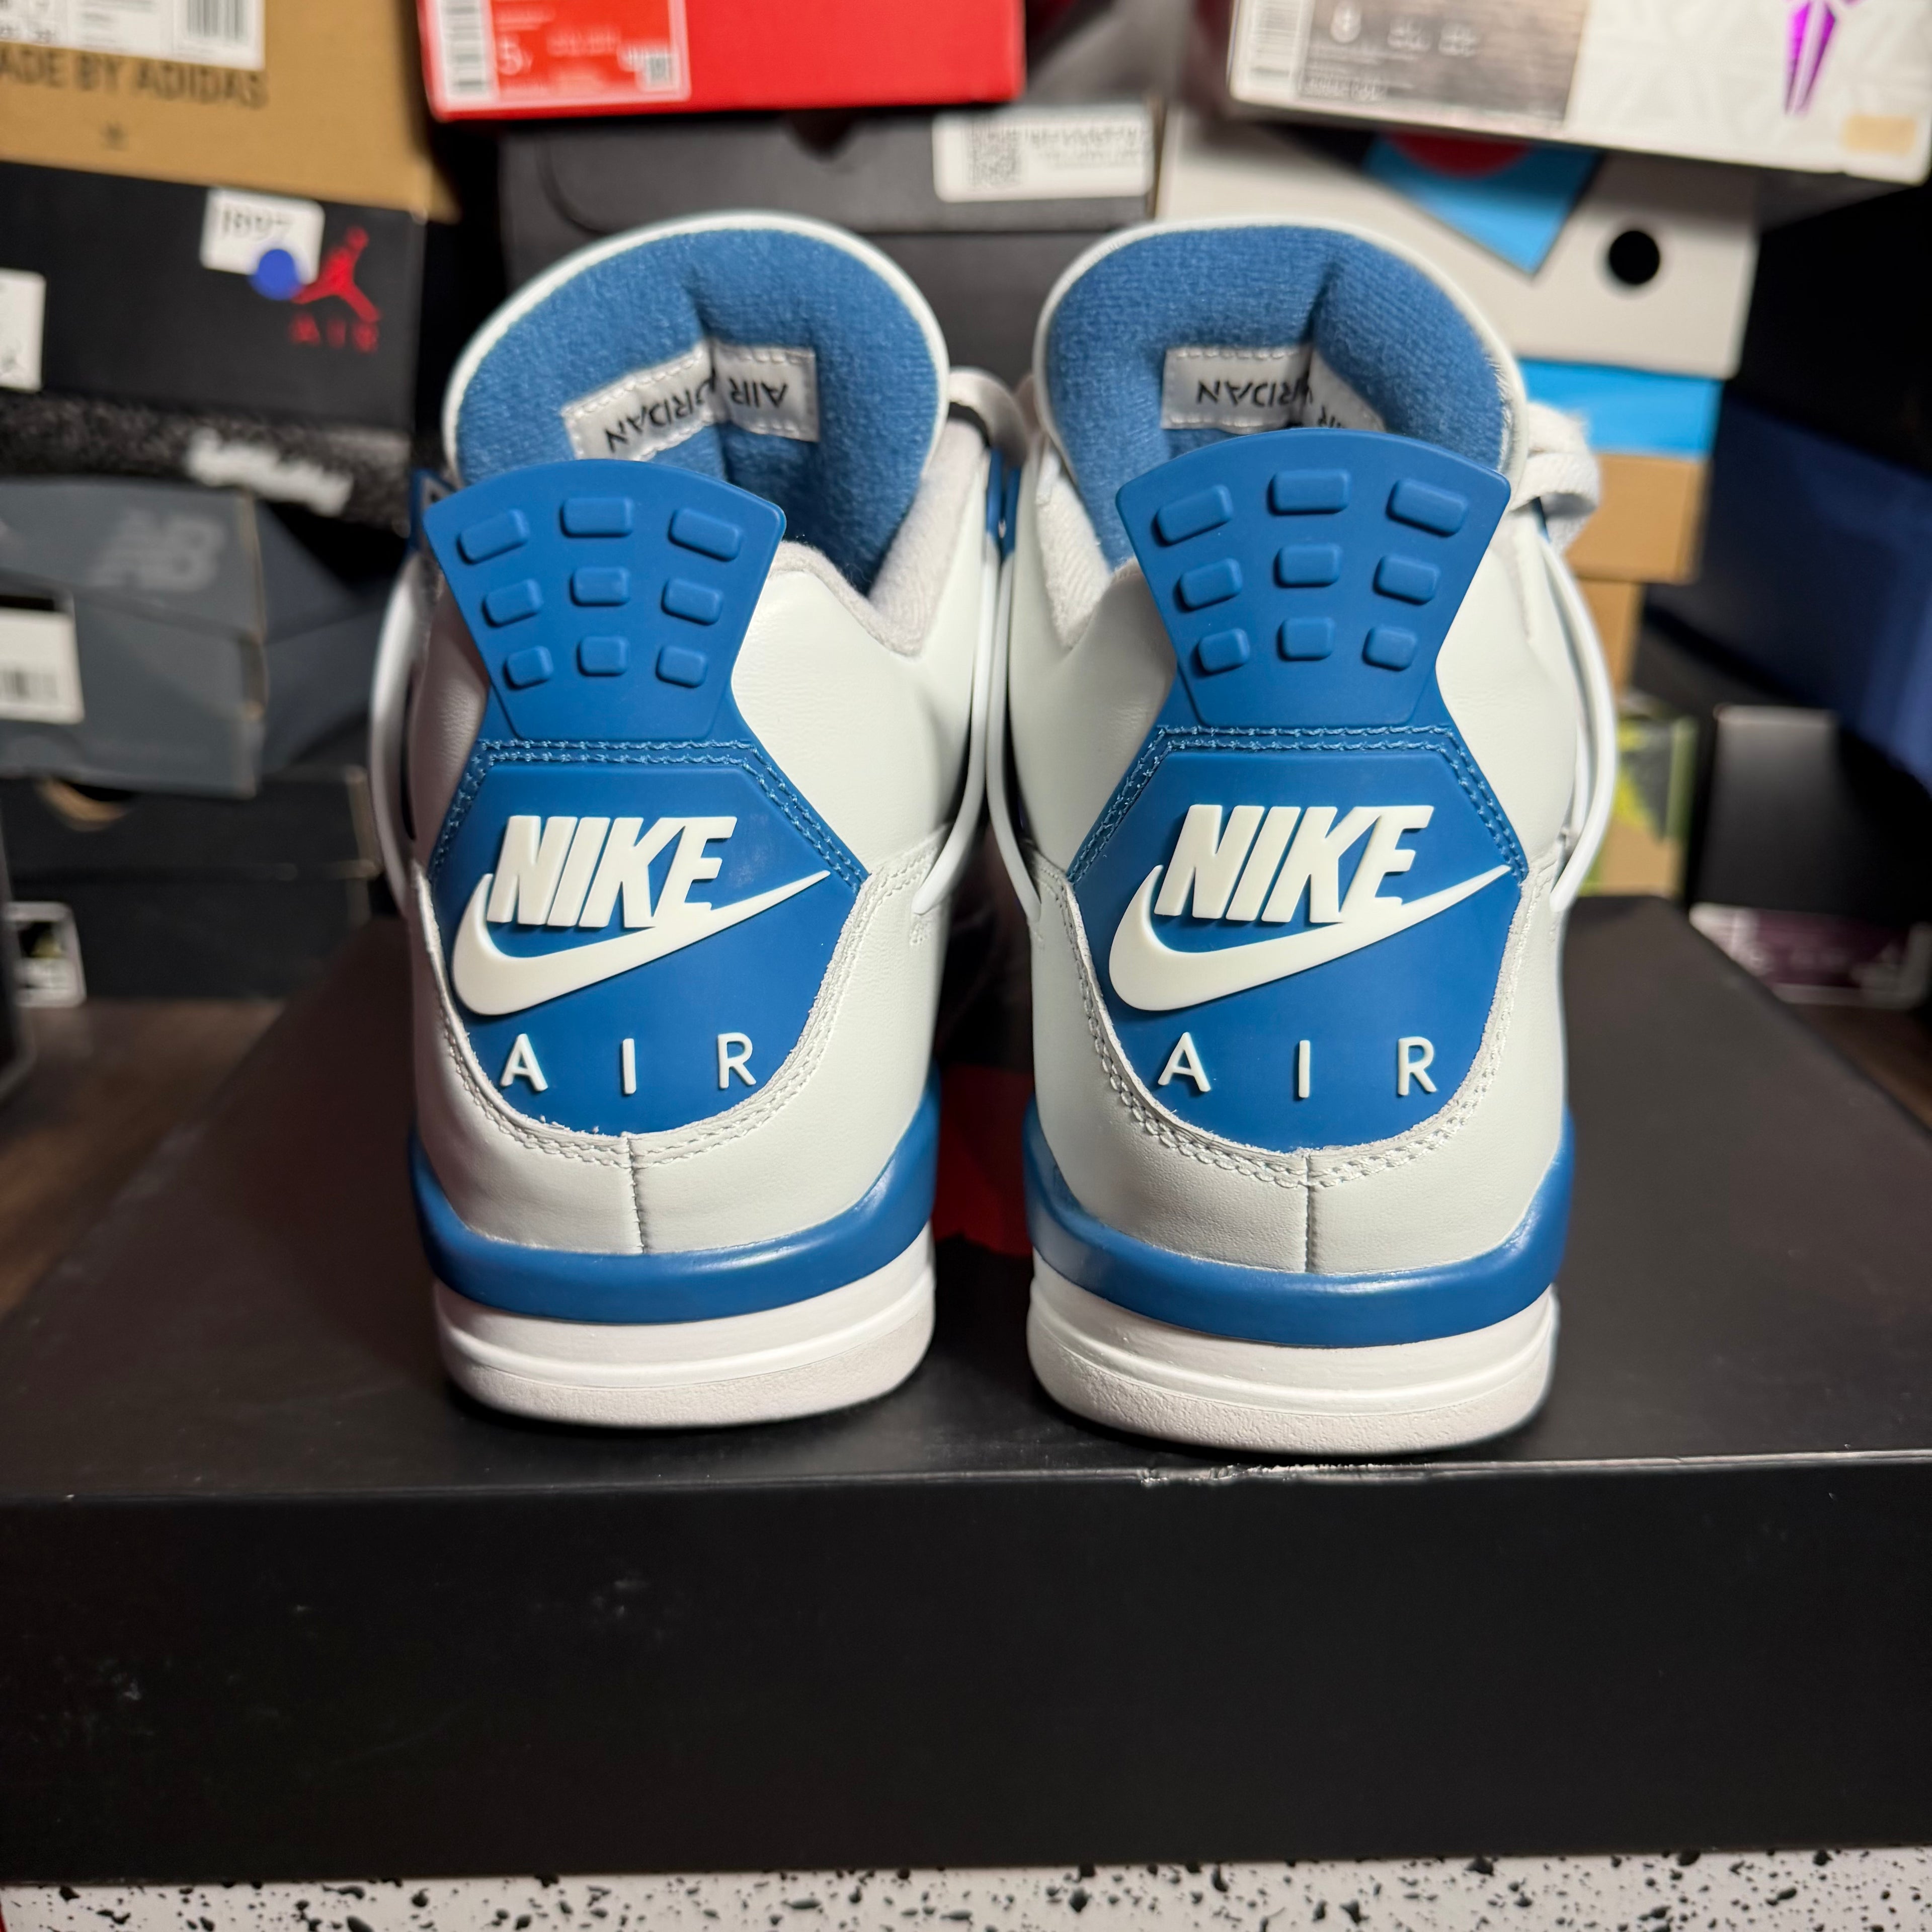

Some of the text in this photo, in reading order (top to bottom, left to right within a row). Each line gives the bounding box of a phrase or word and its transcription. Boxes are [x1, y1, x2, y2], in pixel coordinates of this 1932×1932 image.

[290, 312, 379, 354] AIR
[729, 377, 788, 409] AIR
[486, 815, 738, 928] NIKE
[1154, 804, 1434, 924] NIKE
[500, 1033, 757, 1095] AIR
[1158, 1032, 1437, 1099] AIR
